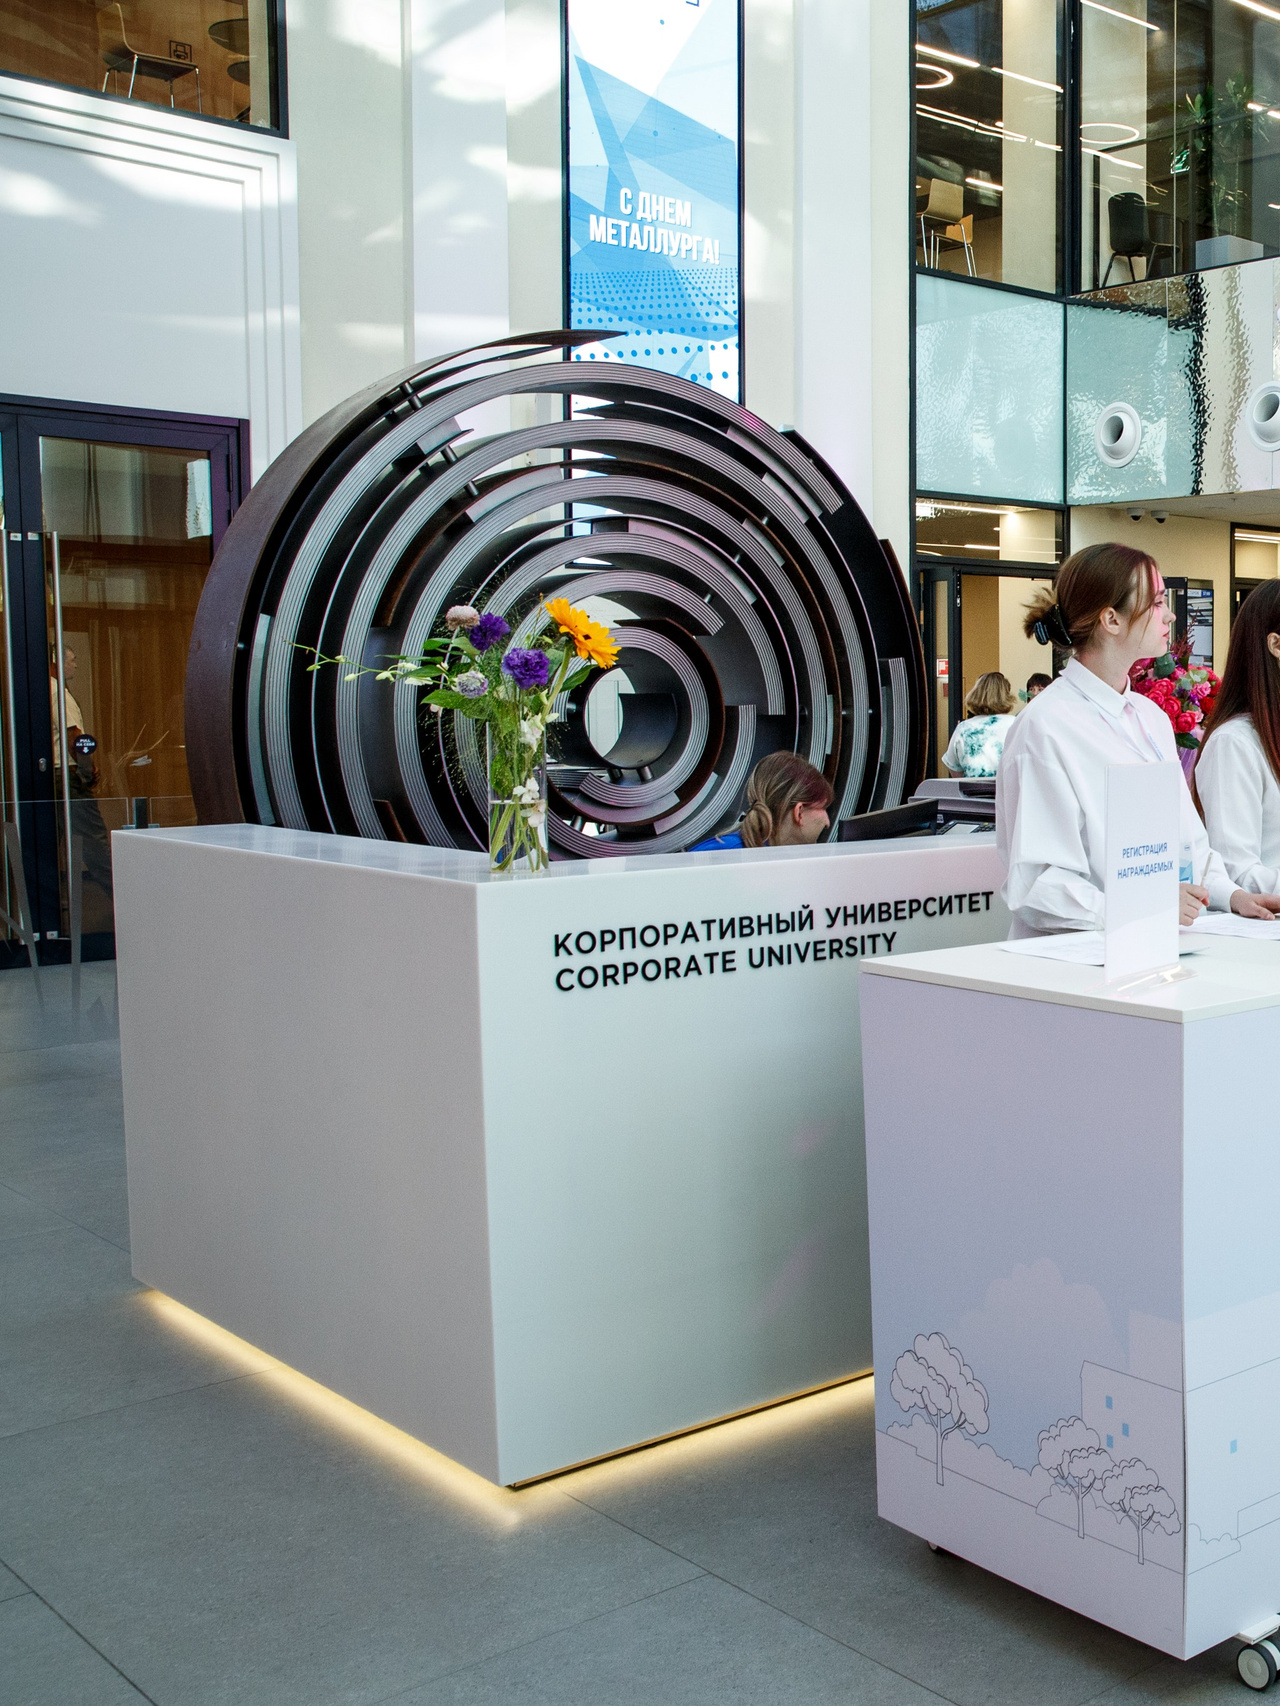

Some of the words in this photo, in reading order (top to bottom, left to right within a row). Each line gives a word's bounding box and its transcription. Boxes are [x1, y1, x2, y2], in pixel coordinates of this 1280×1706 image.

[619, 187, 633, 215] С
[636, 191, 692, 228] ДНЕМ
[589, 214, 720, 265] МЕТАЛЛУРГА!
[1117, 860, 1174, 879] НАГРАЖДАЕМЫХ
[1122, 842, 1168, 859] РЕГИСТРАЦИЯ
[554, 904, 814, 957] КОРПОРАТИВНЫЙ
[825, 891, 994, 928] УНИВЕРСИТЕТ
[555, 950, 737, 992] CORPORATE
[748, 931, 897, 969] UNIVERSITY
